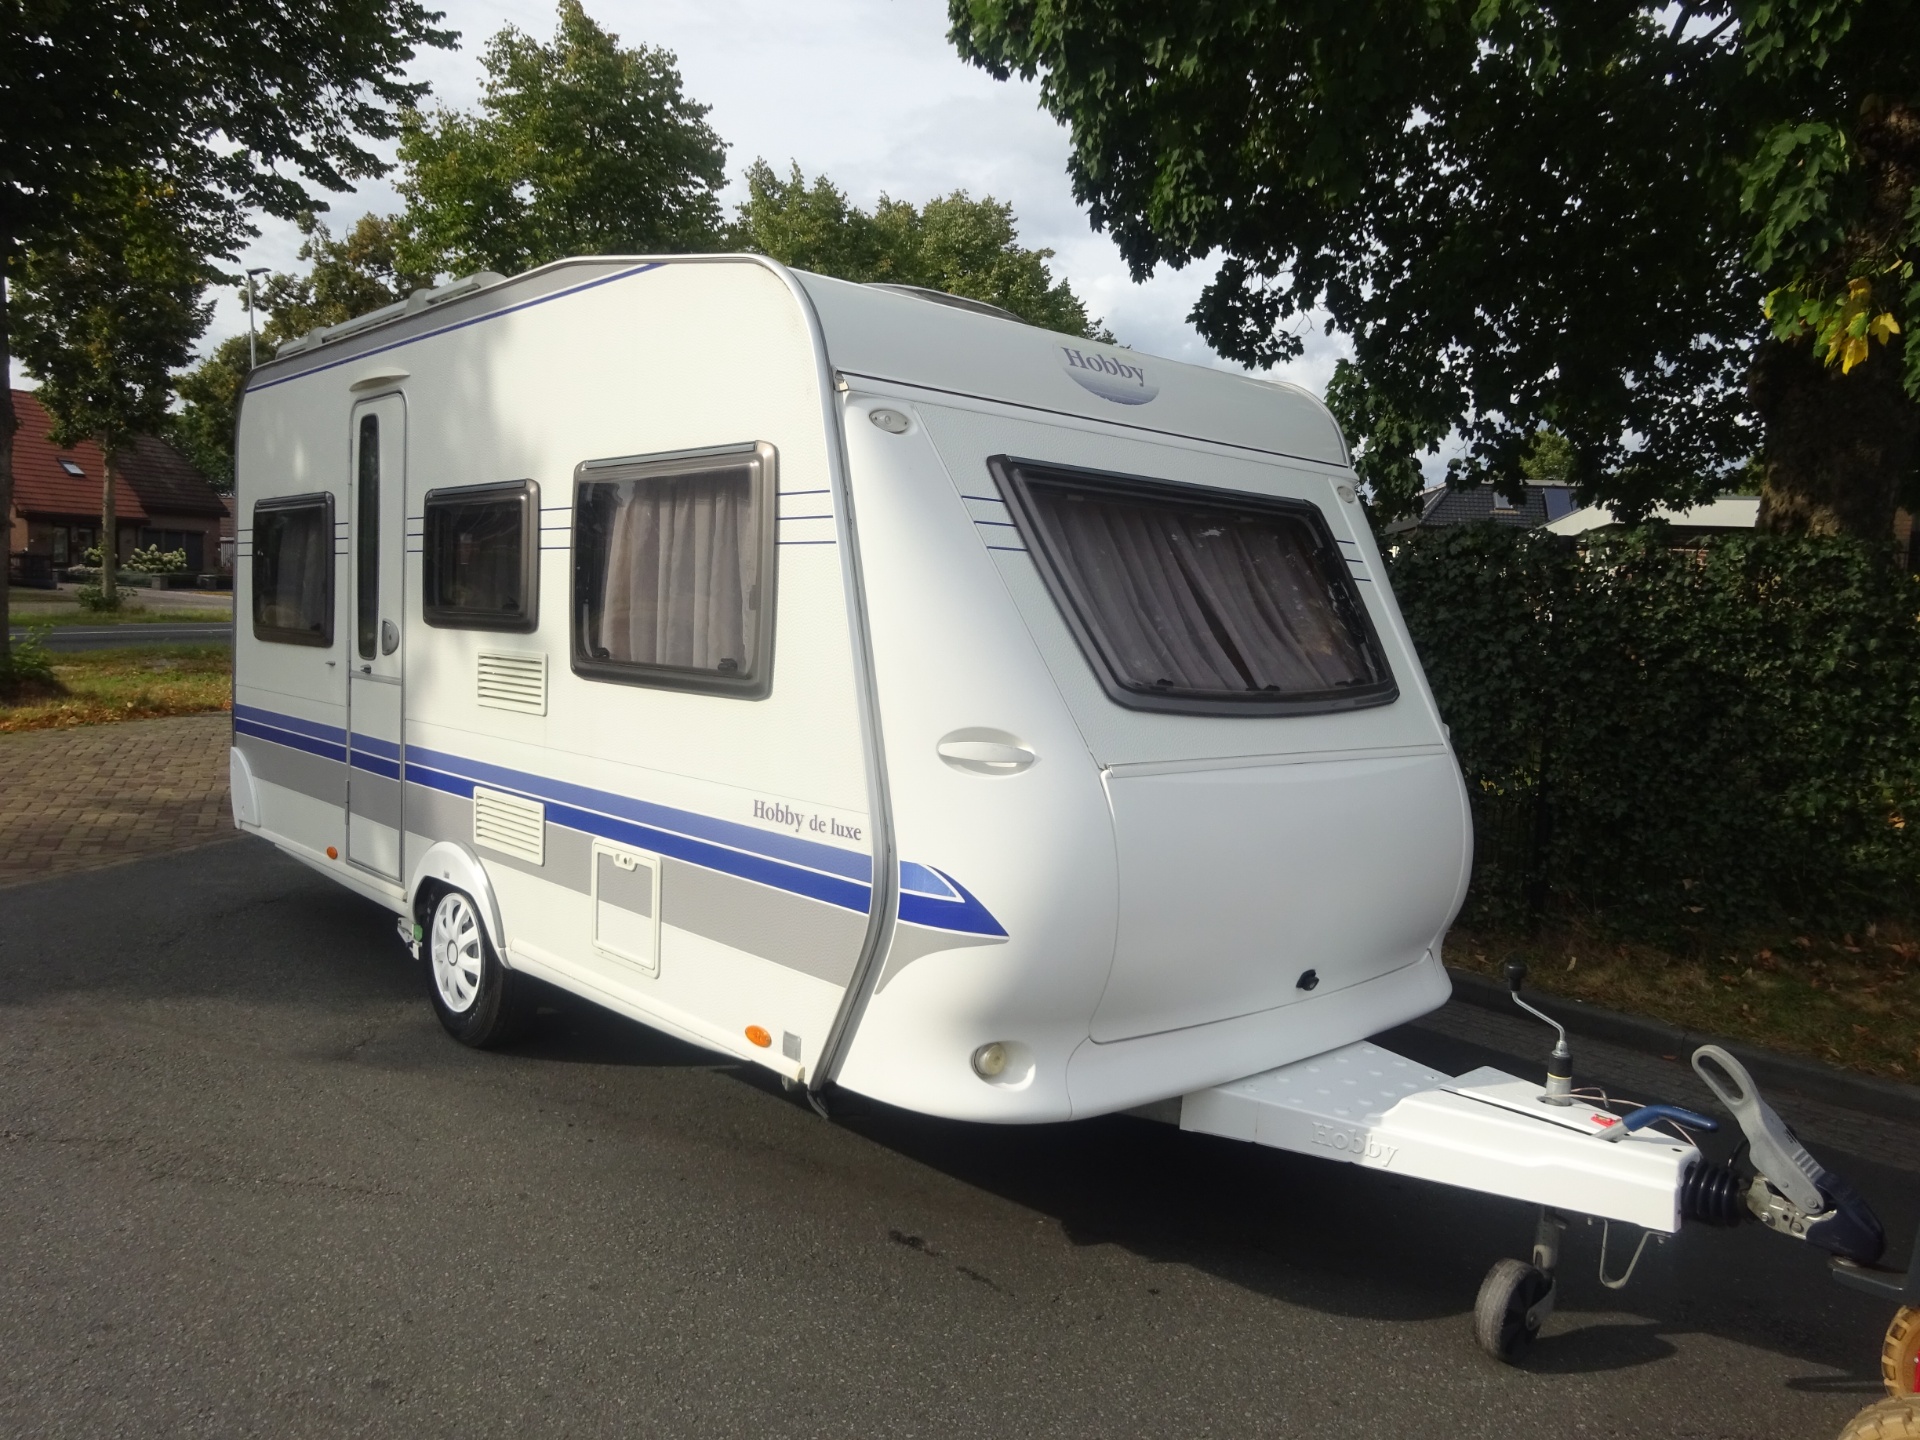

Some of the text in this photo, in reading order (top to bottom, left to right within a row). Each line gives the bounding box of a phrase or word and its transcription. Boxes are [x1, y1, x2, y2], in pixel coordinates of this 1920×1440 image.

[1061, 346, 1144, 387] Hobby
[753, 799, 862, 841] Hobby de luxe
[1311, 1121, 1399, 1168] Hobby
